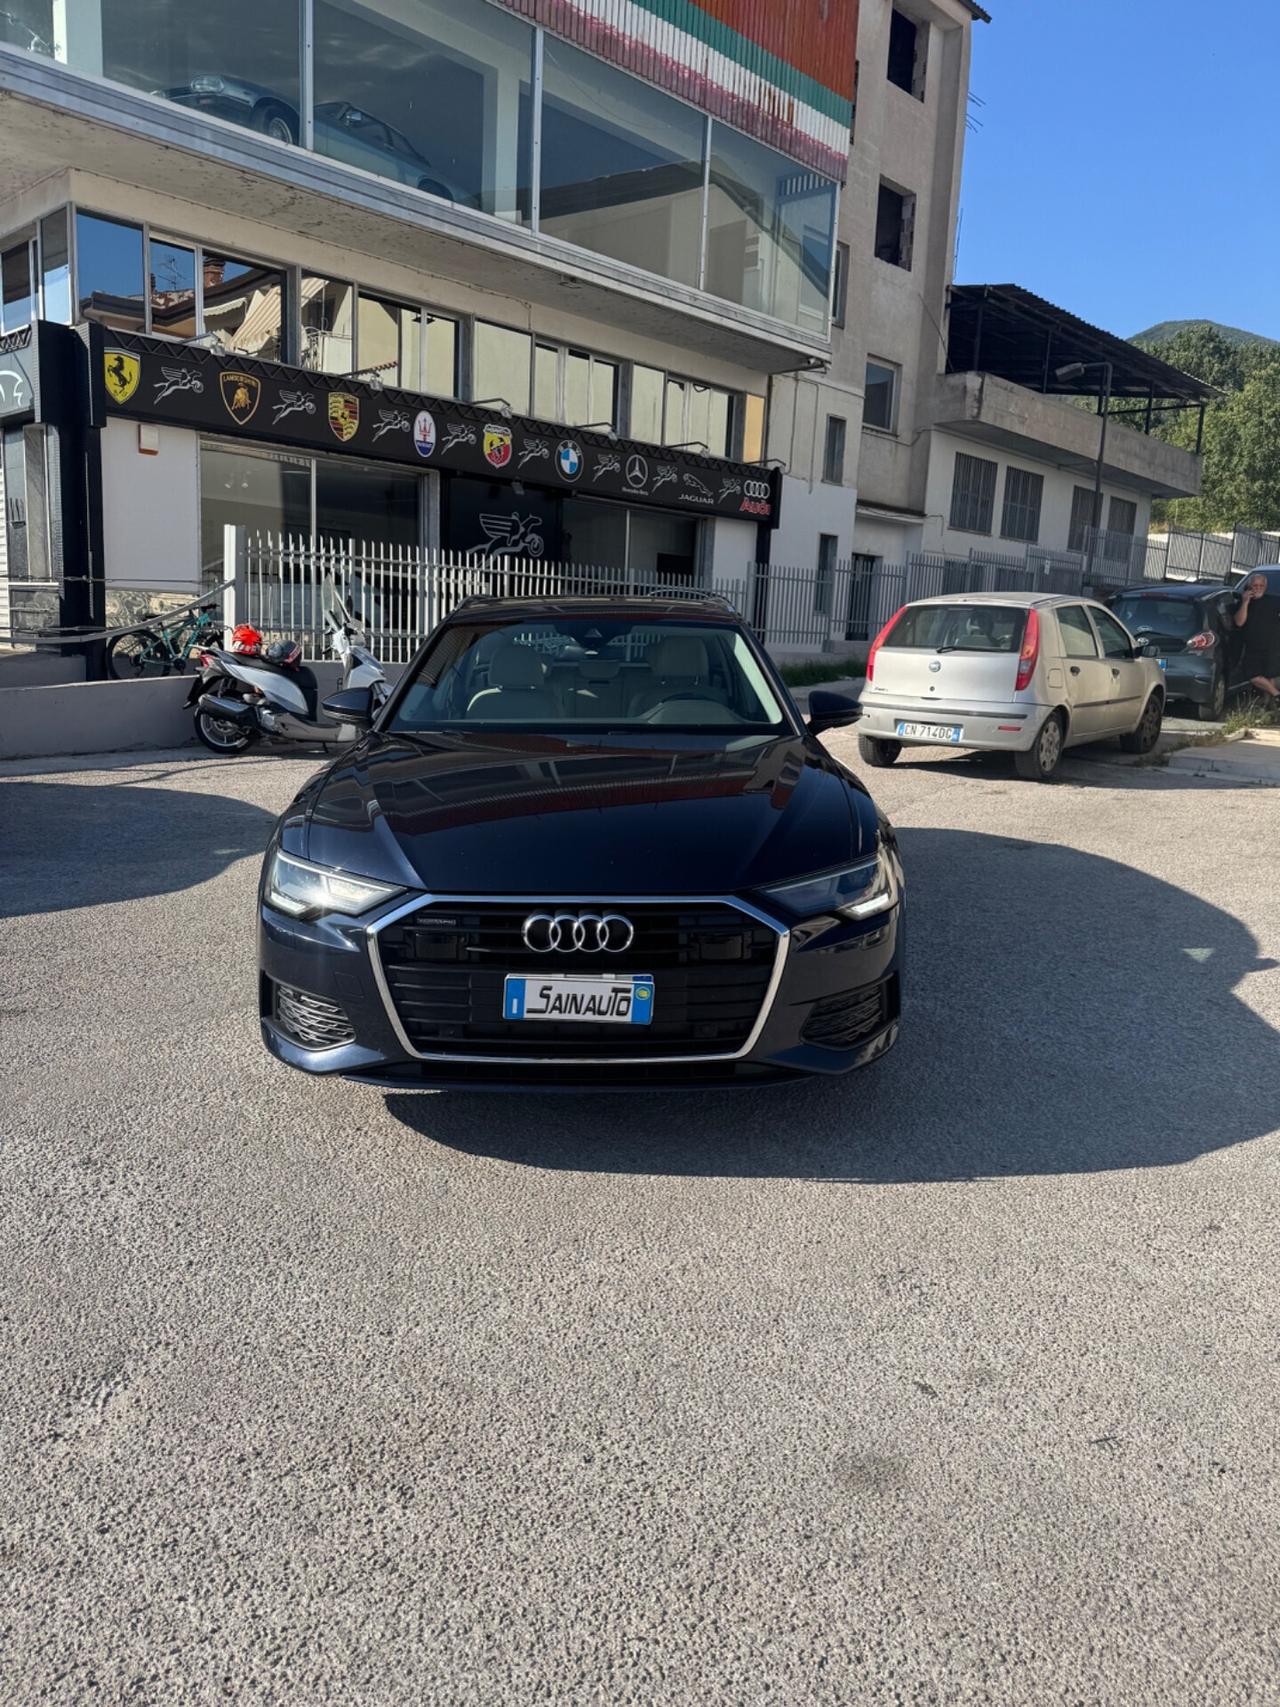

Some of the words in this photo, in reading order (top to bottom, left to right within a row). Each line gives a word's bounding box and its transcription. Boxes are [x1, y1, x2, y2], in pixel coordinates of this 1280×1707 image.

[678, 493, 714, 505] JAGUAR
[739, 497, 771, 516] Audi
[526, 985, 632, 1017] SAINAUTO
